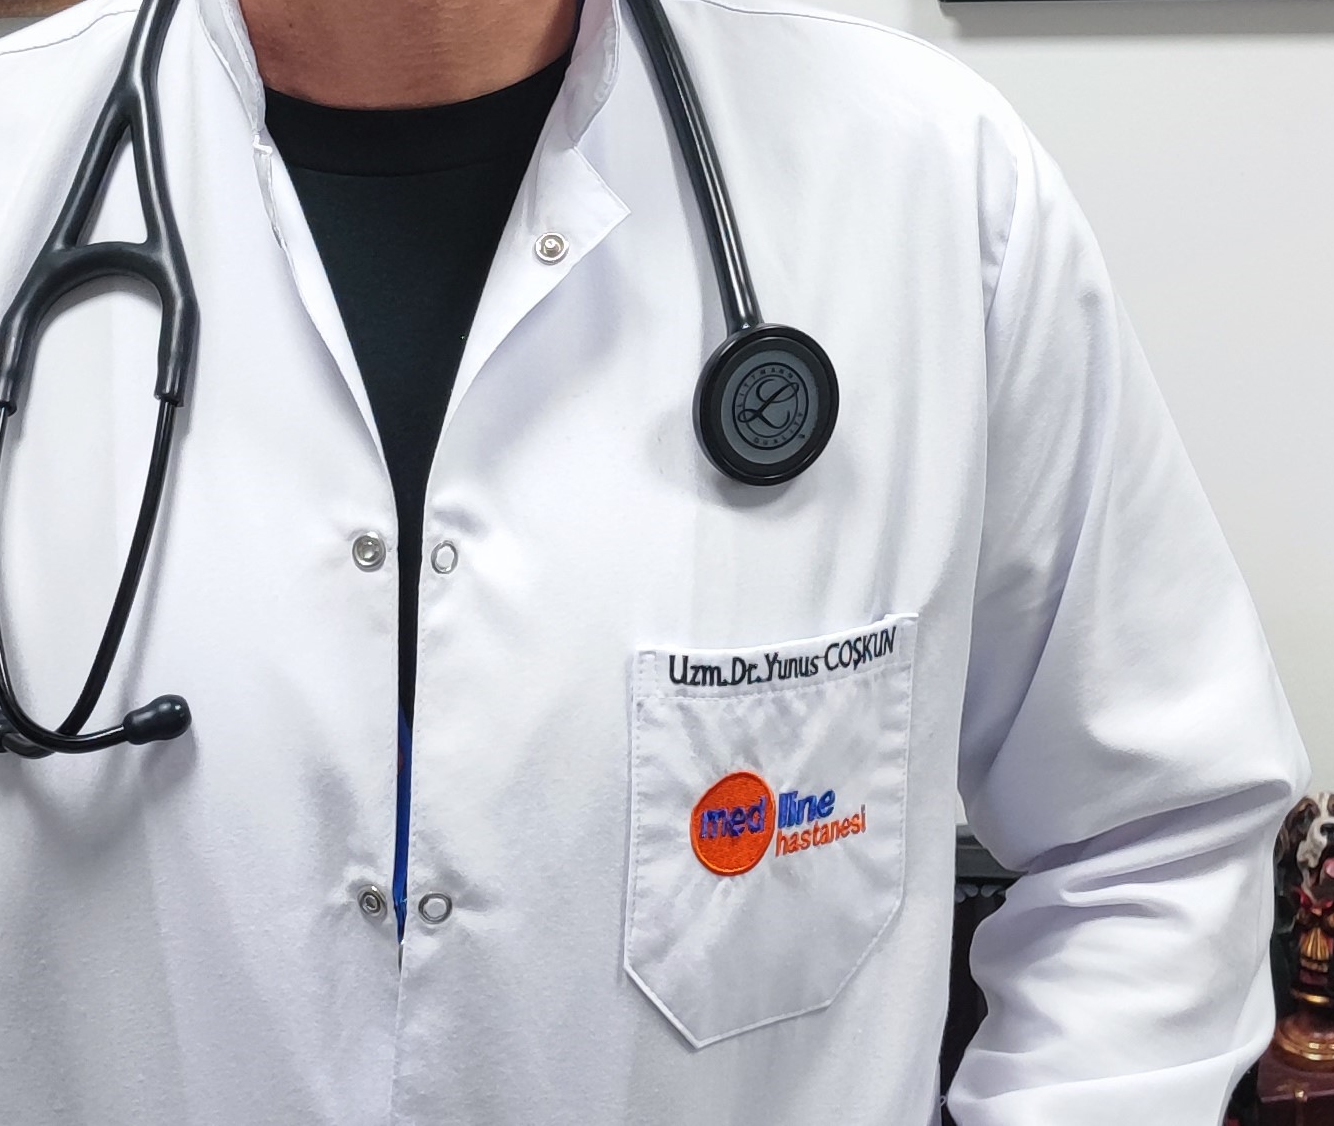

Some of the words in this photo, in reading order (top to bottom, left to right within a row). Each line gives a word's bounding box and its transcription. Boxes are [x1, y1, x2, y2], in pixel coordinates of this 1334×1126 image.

[824, 626, 897, 670] COŞKUN
[699, 794, 767, 839] med
[775, 803, 867, 858] hastanesi
